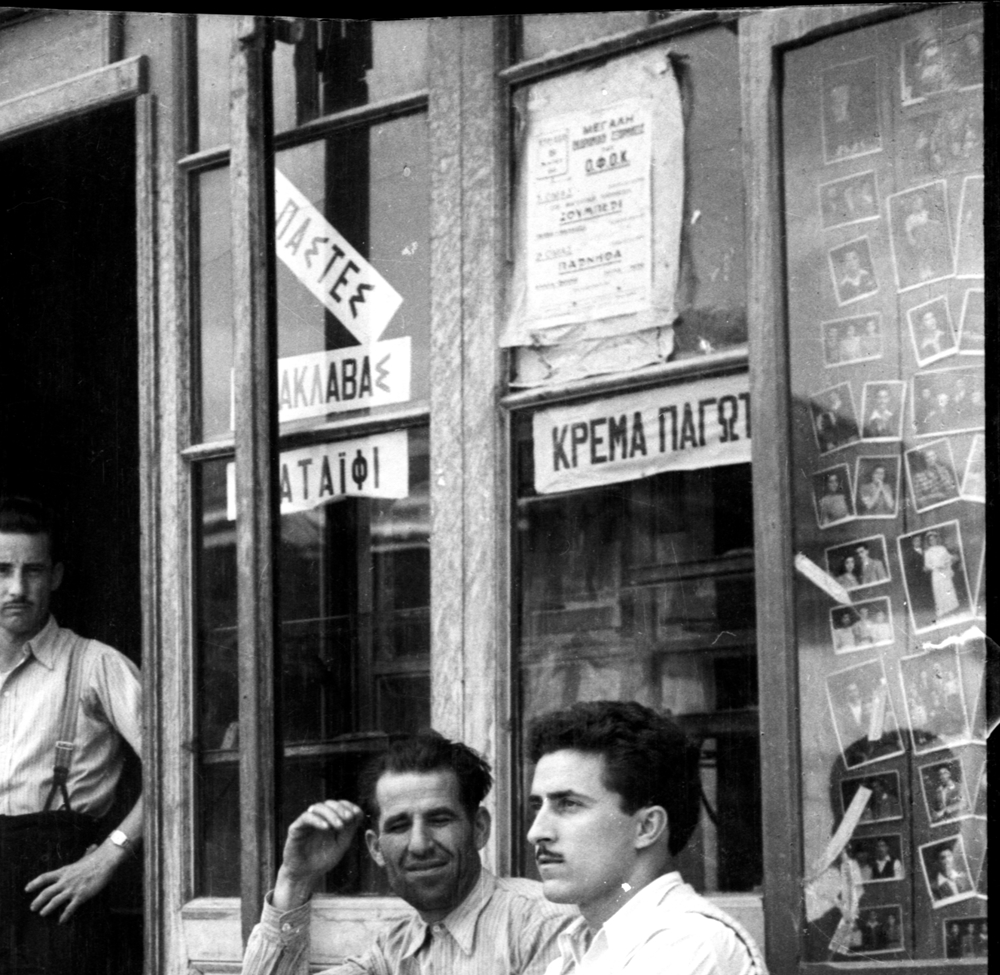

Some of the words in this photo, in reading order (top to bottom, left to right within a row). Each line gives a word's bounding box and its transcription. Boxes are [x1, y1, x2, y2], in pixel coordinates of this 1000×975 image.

[582, 114, 635, 135] ΜΕΓΑΛΗ
[276, 197, 376, 319] ΠΑΣΤΕΣ
[279, 352, 392, 411] ΑΚΛΑΒΑΣ
[551, 411, 648, 472] ΚΡΕΜΑ
[280, 446, 380, 504] ΑΤΑΪΦΙ
